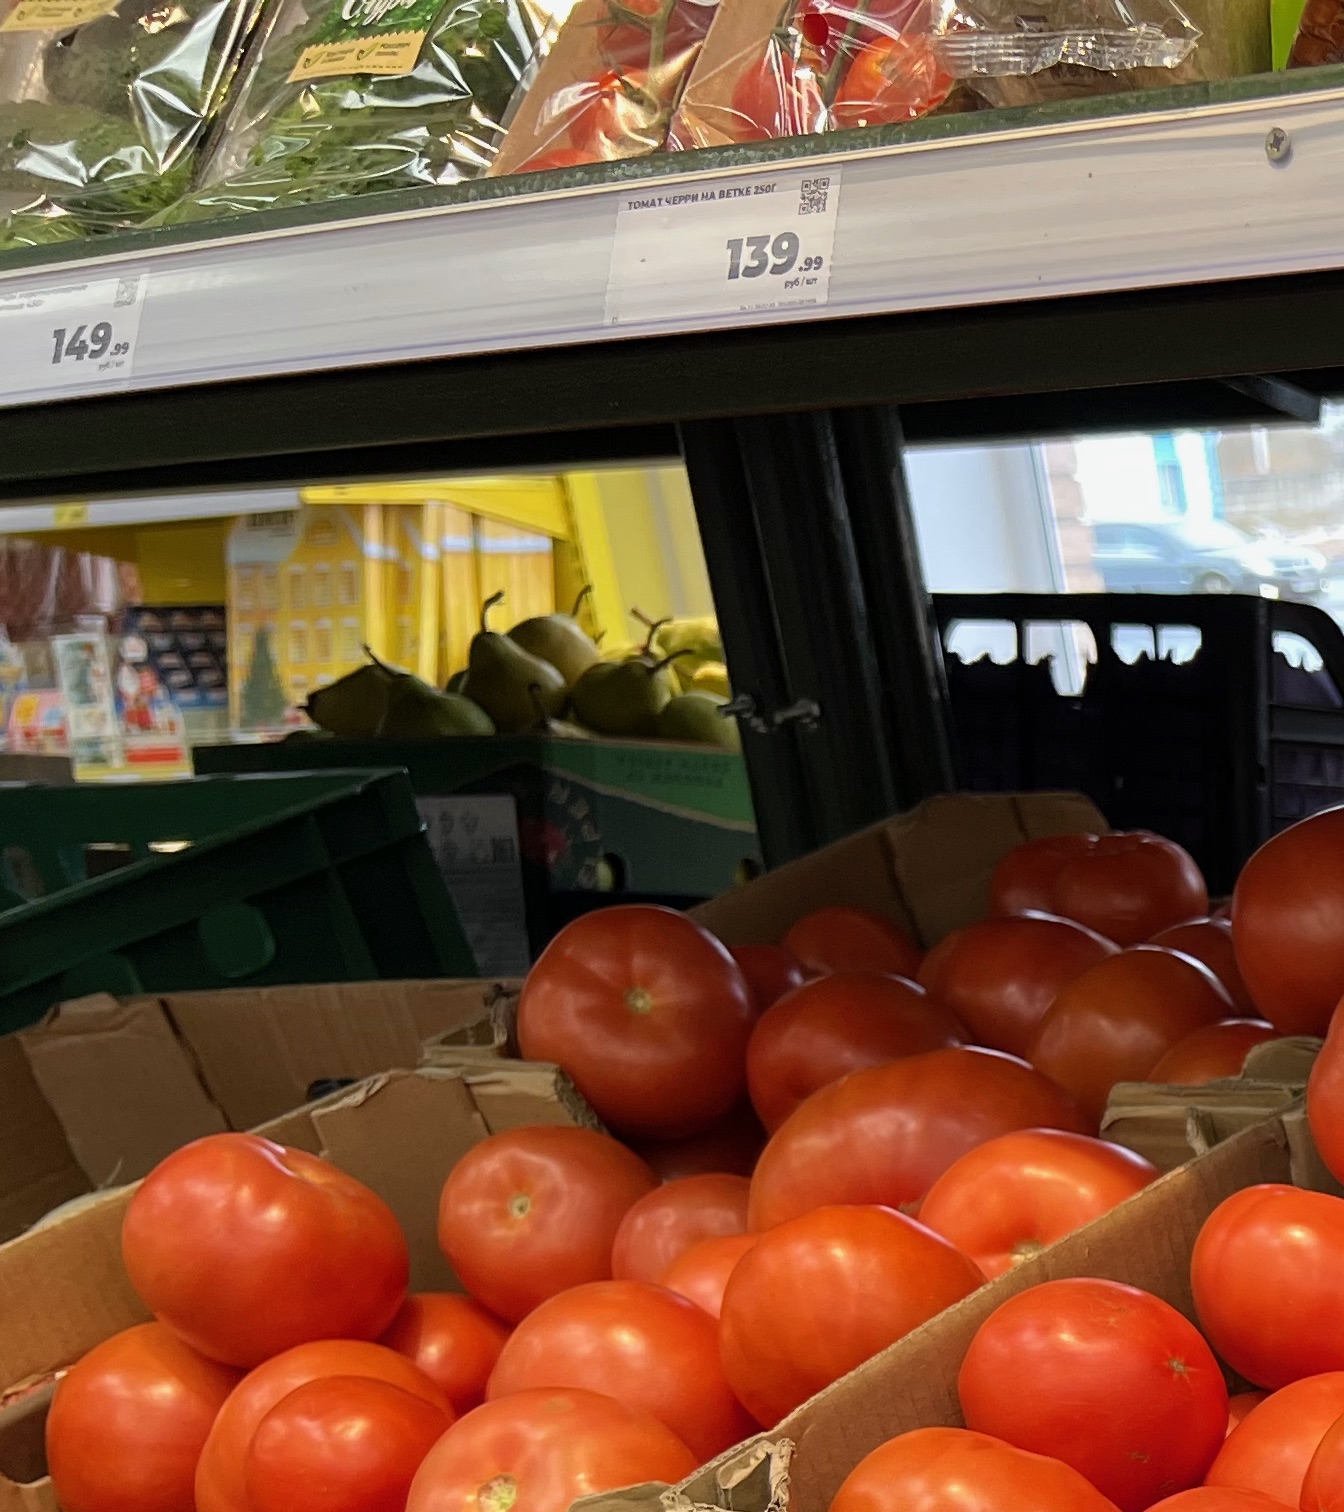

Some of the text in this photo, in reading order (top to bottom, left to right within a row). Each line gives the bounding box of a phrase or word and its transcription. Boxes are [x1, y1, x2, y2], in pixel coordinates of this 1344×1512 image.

[628, 197, 662, 210] ТОМАТ
[665, 194, 699, 206] ЧЕРРИ
[701, 190, 717, 201] НА
[719, 187, 752, 199] ВЕТКЕ
